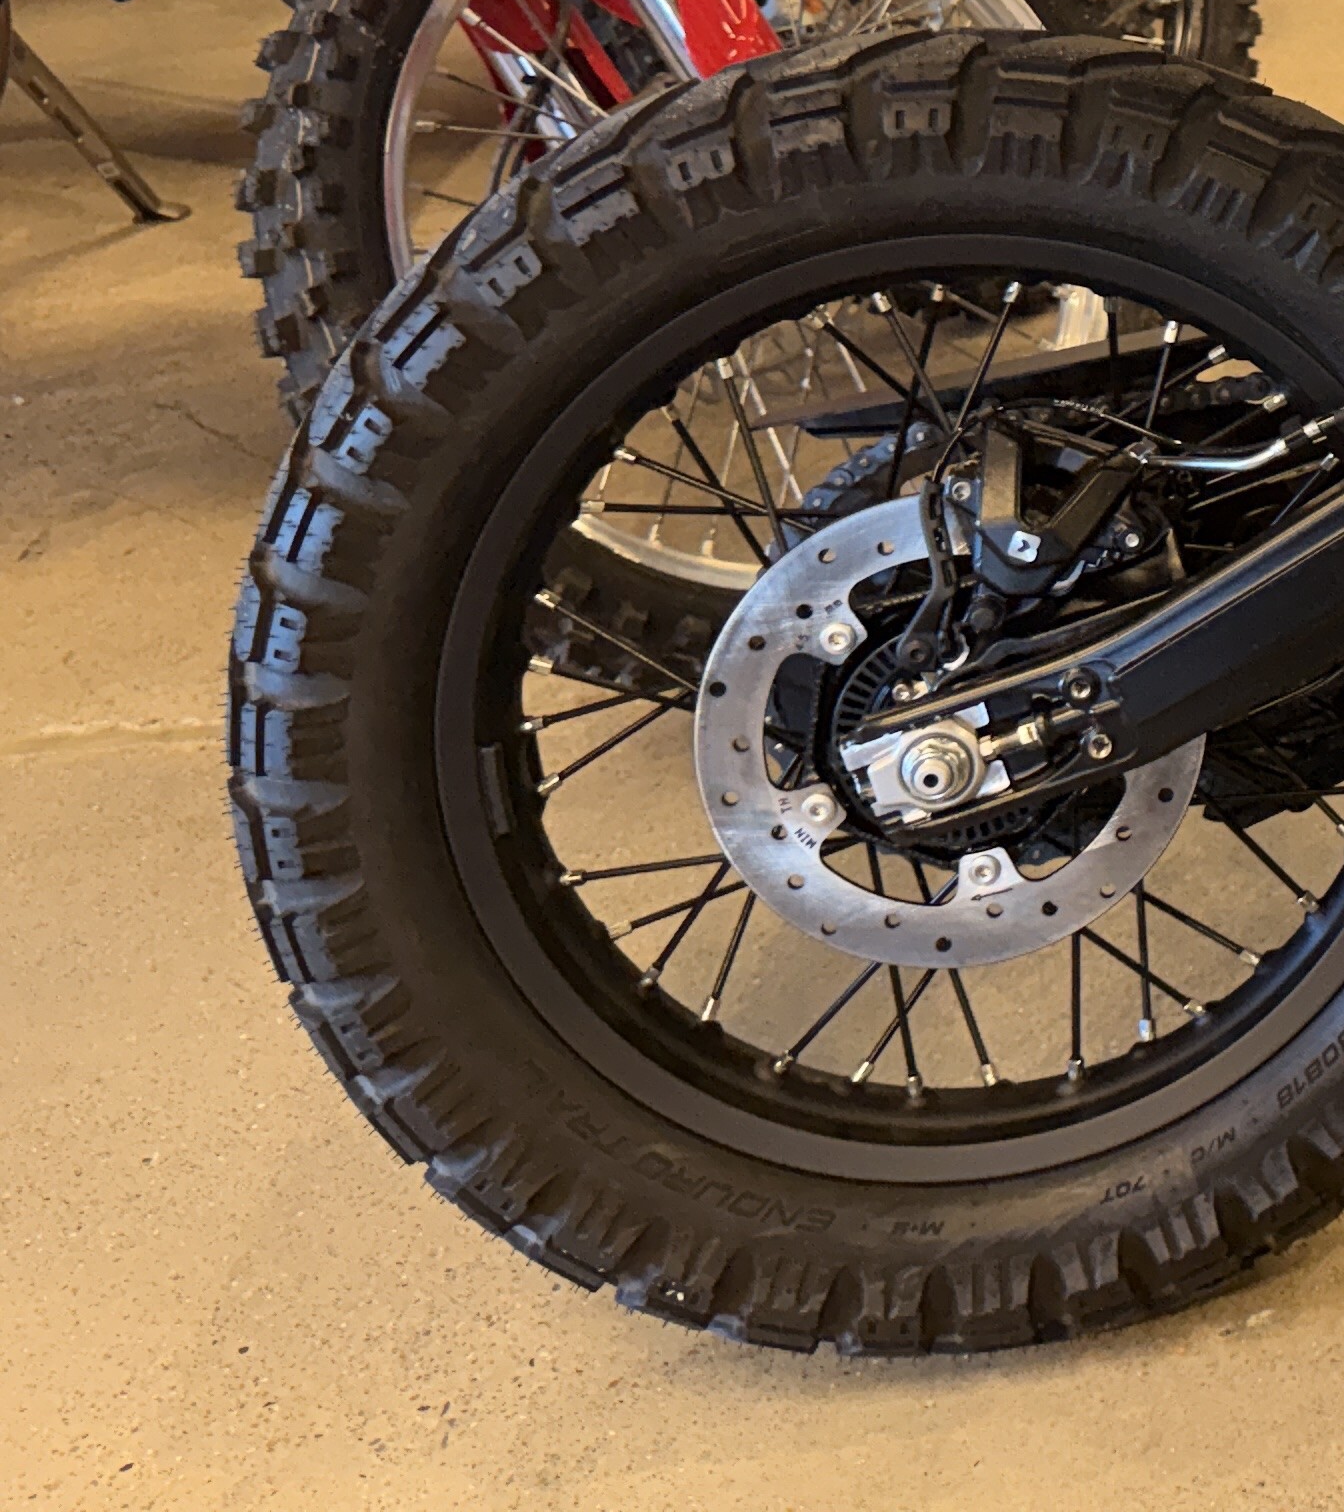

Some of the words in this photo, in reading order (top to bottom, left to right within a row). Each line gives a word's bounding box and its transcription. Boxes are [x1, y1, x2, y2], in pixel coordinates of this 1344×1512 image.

[793, 826, 818, 850] MIN
[631, 1151, 837, 1234] ENDURO
[1100, 1175, 1147, 1204] 70T
